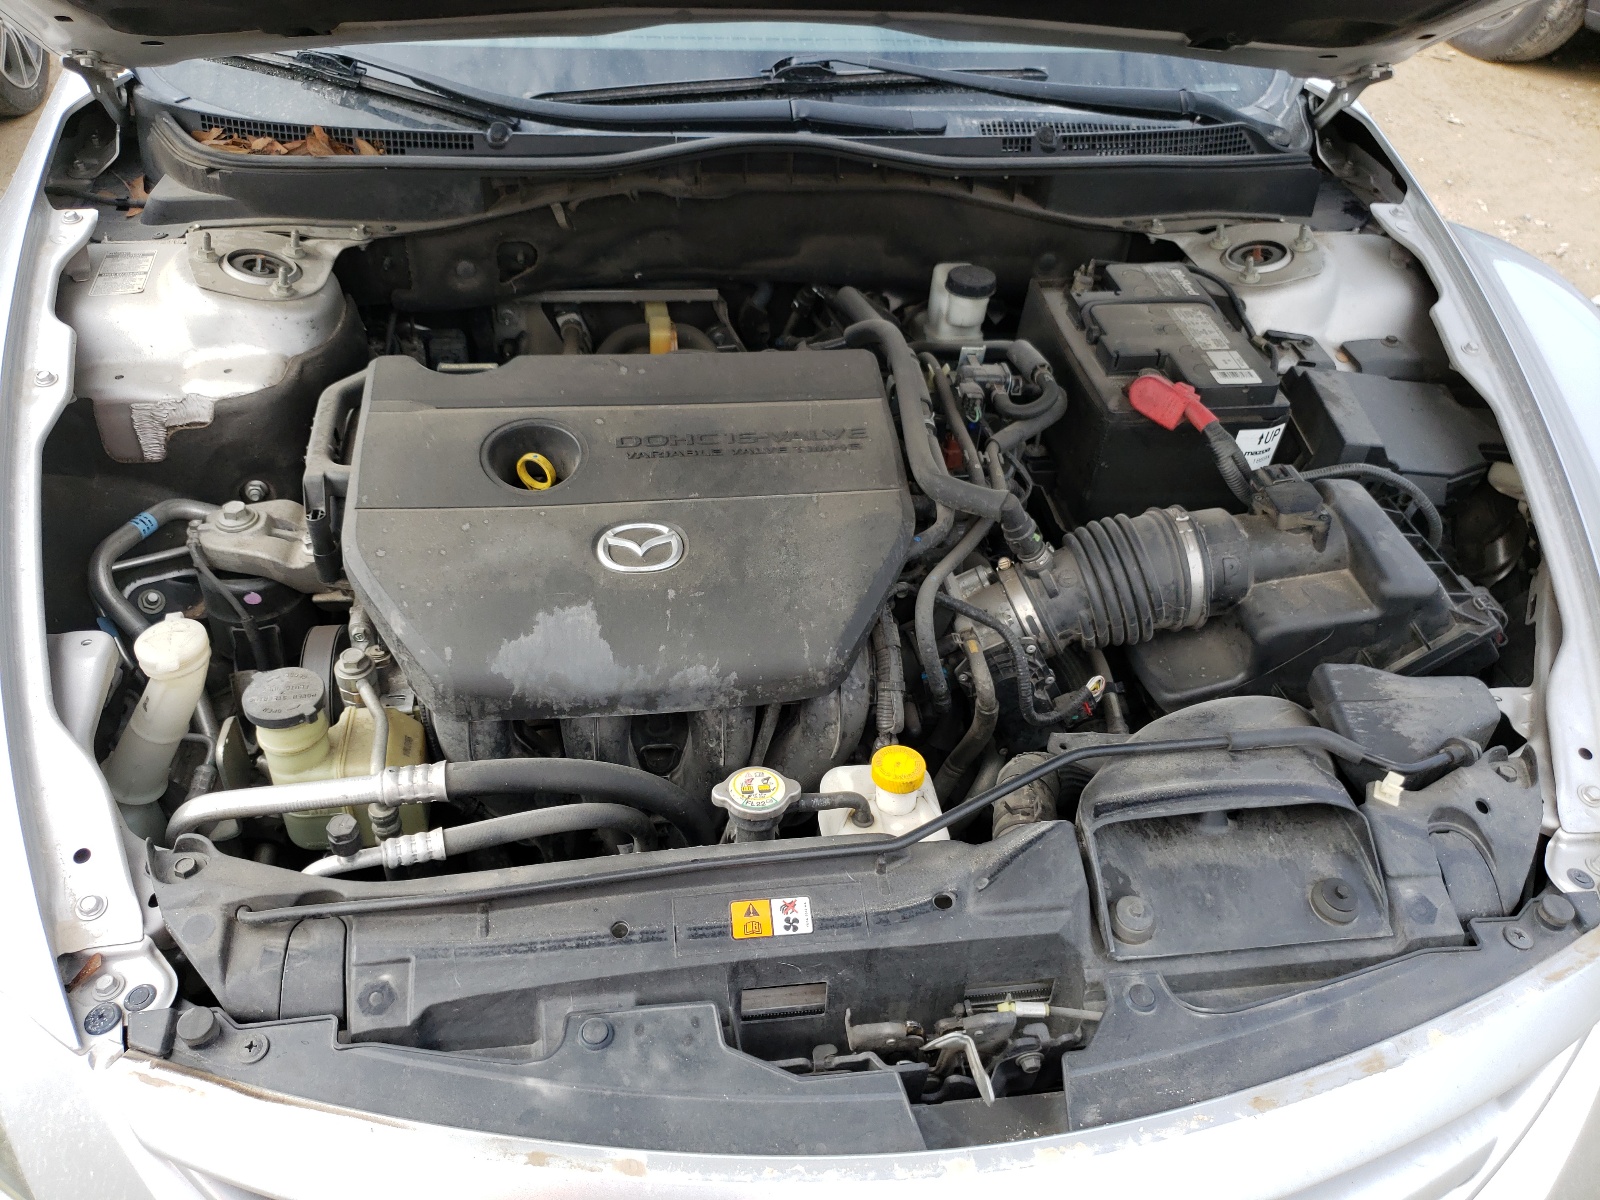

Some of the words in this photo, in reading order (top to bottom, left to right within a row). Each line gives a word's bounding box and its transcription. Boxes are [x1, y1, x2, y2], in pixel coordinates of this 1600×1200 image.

[615, 433, 720, 449] DOHC
[1264, 427, 1281, 445] UP
[626, 448, 723, 460] VARIABLE
